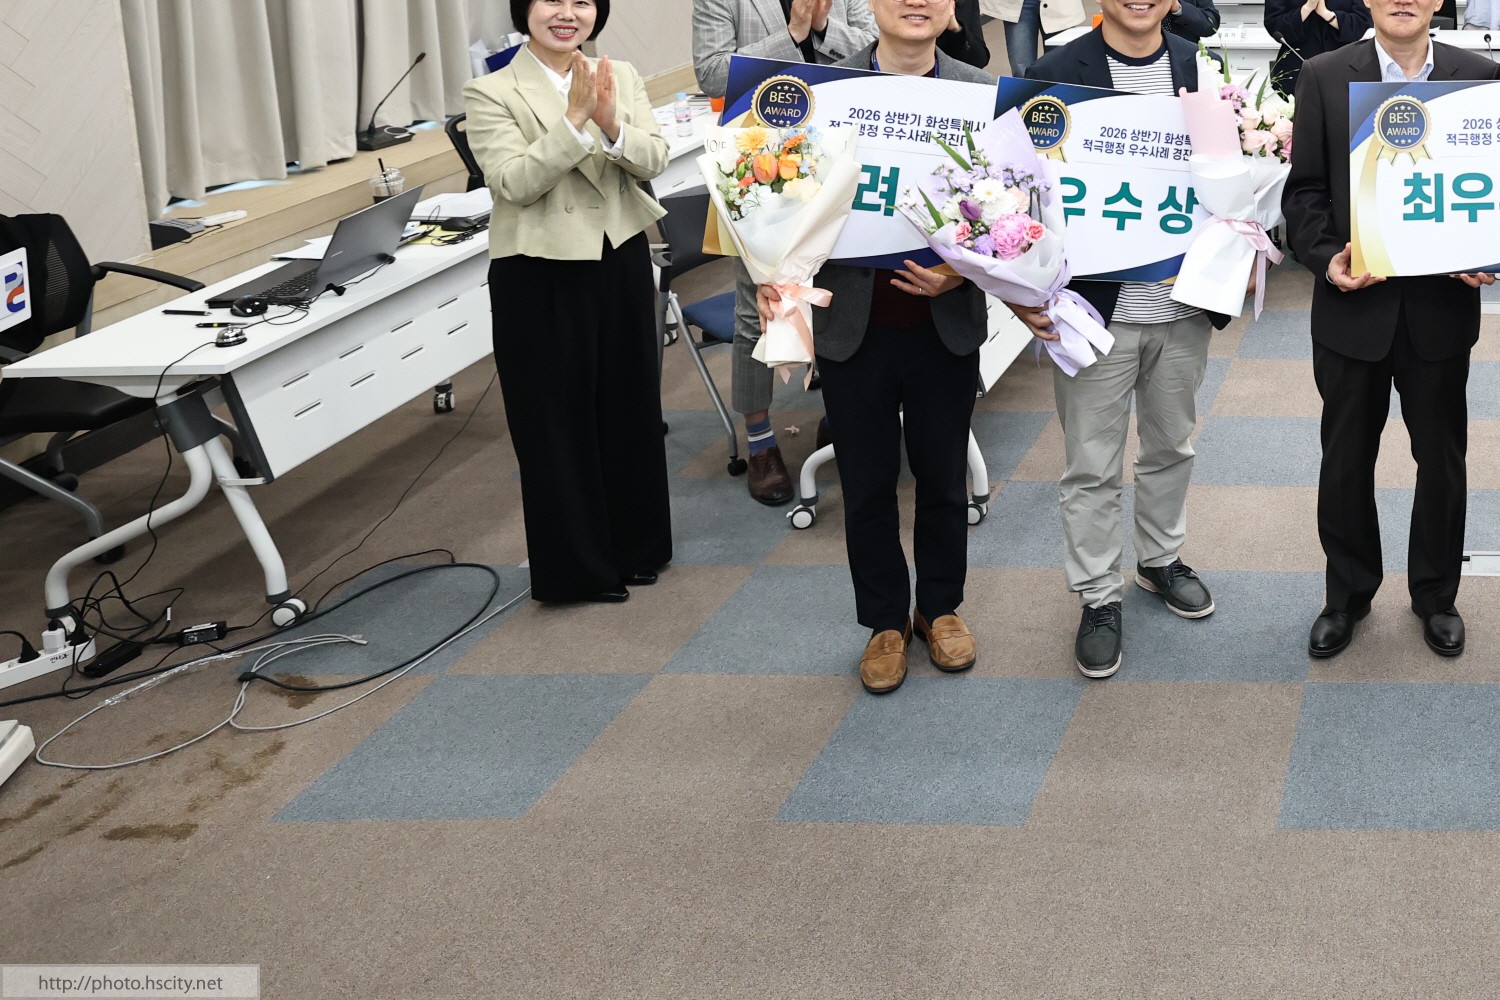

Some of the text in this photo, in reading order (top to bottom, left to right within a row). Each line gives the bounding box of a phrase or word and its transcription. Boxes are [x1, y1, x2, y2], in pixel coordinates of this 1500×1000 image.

[769, 90, 802, 105] BEST
[764, 106, 801, 118] AWARD
[848, 107, 881, 122] 2026
[885, 111, 921, 127] 상반기
[1031, 111, 1060, 125] BEST
[1389, 112, 1417, 123] BEST
[1462, 118, 1493, 130] 2026
[882, 126, 932, 143] 우수사례
[1028, 126, 1060, 138] AWARD
[1099, 126, 1127, 139] 2026
[1130, 128, 1161, 143] 상반기
[1386, 127, 1420, 136] AWARD
[1446, 132, 1492, 146] 적극행정
[1083, 139, 1192, 161] 적극행정 우수사례 경진
[1060, 176, 1200, 235] 우수상
